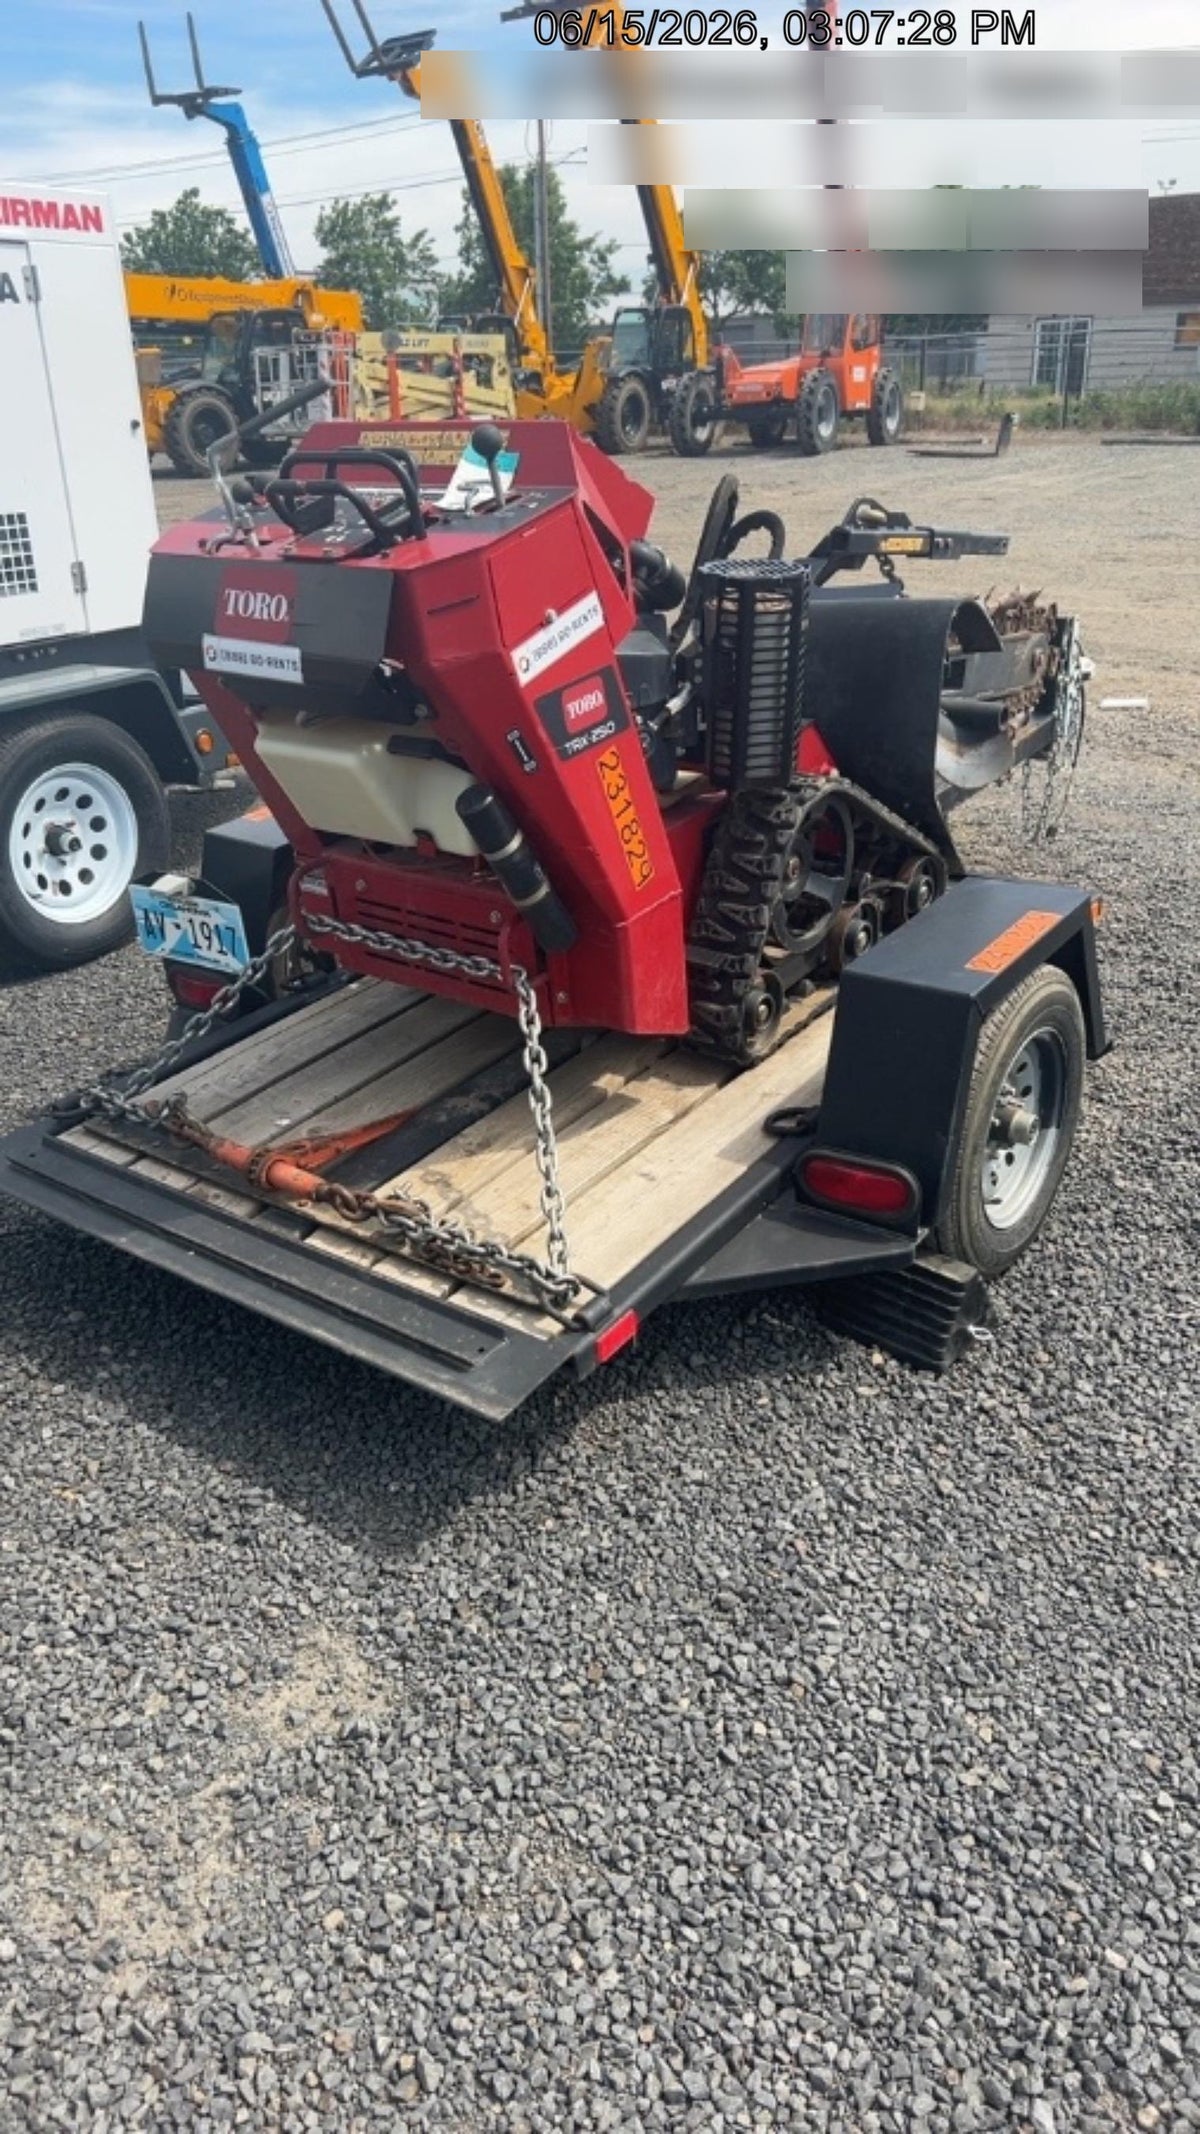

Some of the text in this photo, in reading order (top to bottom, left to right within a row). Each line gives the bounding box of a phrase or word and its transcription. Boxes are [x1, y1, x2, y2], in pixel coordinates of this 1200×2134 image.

[0, 197, 103, 233] IRMAN
[223, 588, 287, 622] TORO
[566, 688, 604, 719] TORO
[563, 720, 616, 756] TRX-250
[599, 750, 653, 888] 231829
